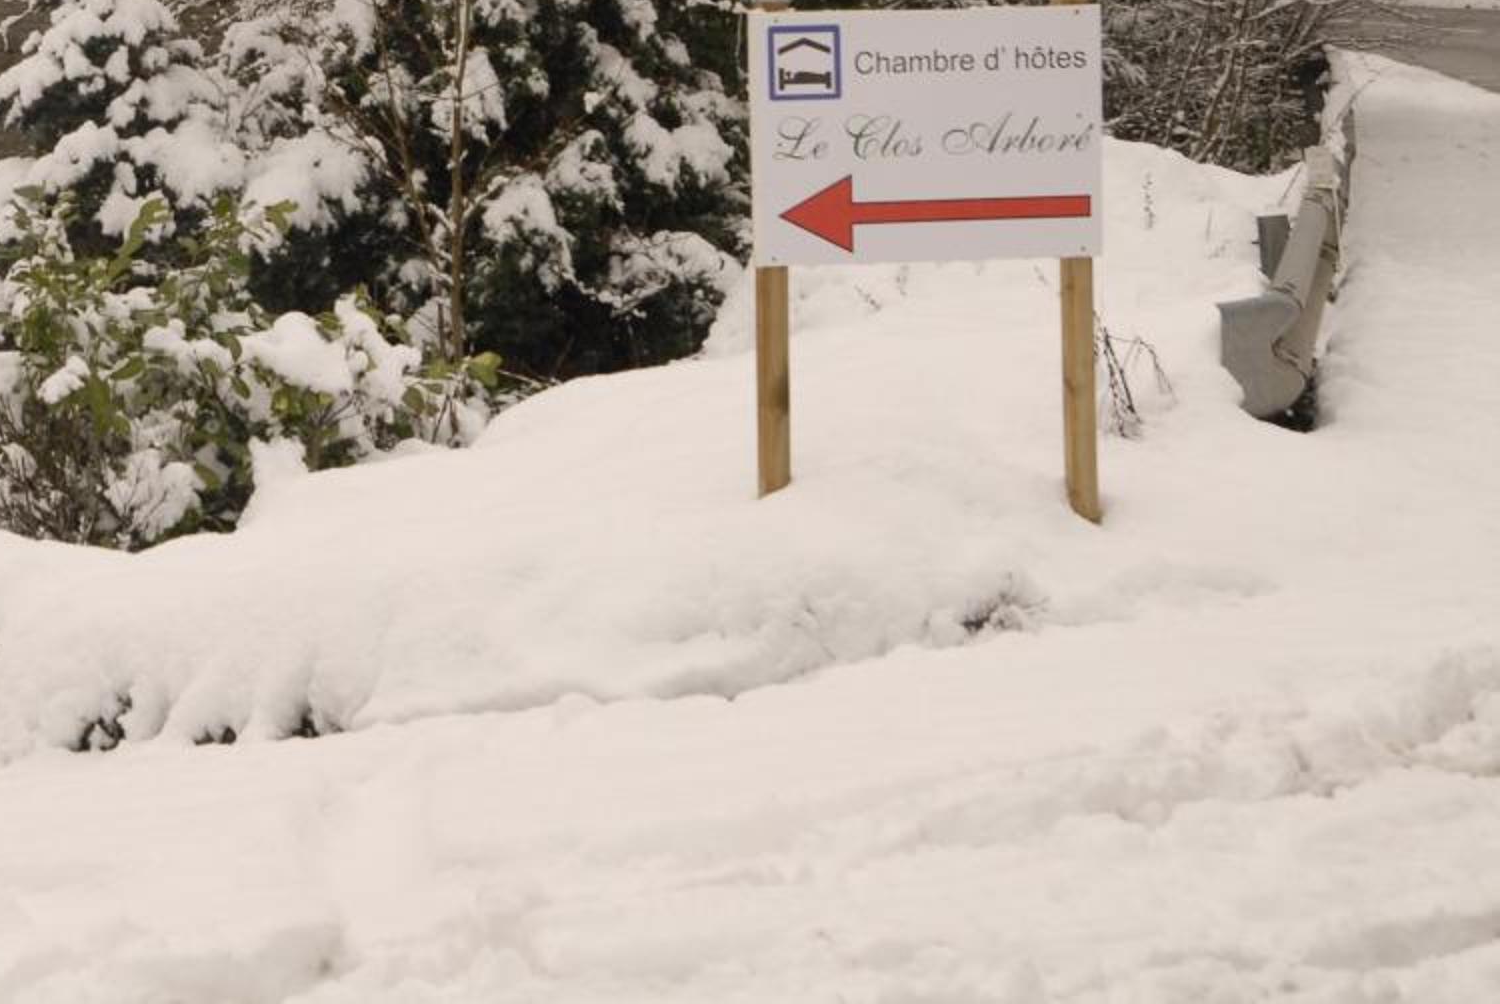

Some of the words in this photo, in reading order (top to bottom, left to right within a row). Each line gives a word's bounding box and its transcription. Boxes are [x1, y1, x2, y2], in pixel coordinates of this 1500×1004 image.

[854, 49, 975, 75] Chambre
[1014, 46, 1088, 70] hôtes
[771, 115, 829, 161] Le
[844, 113, 922, 161] Clos
